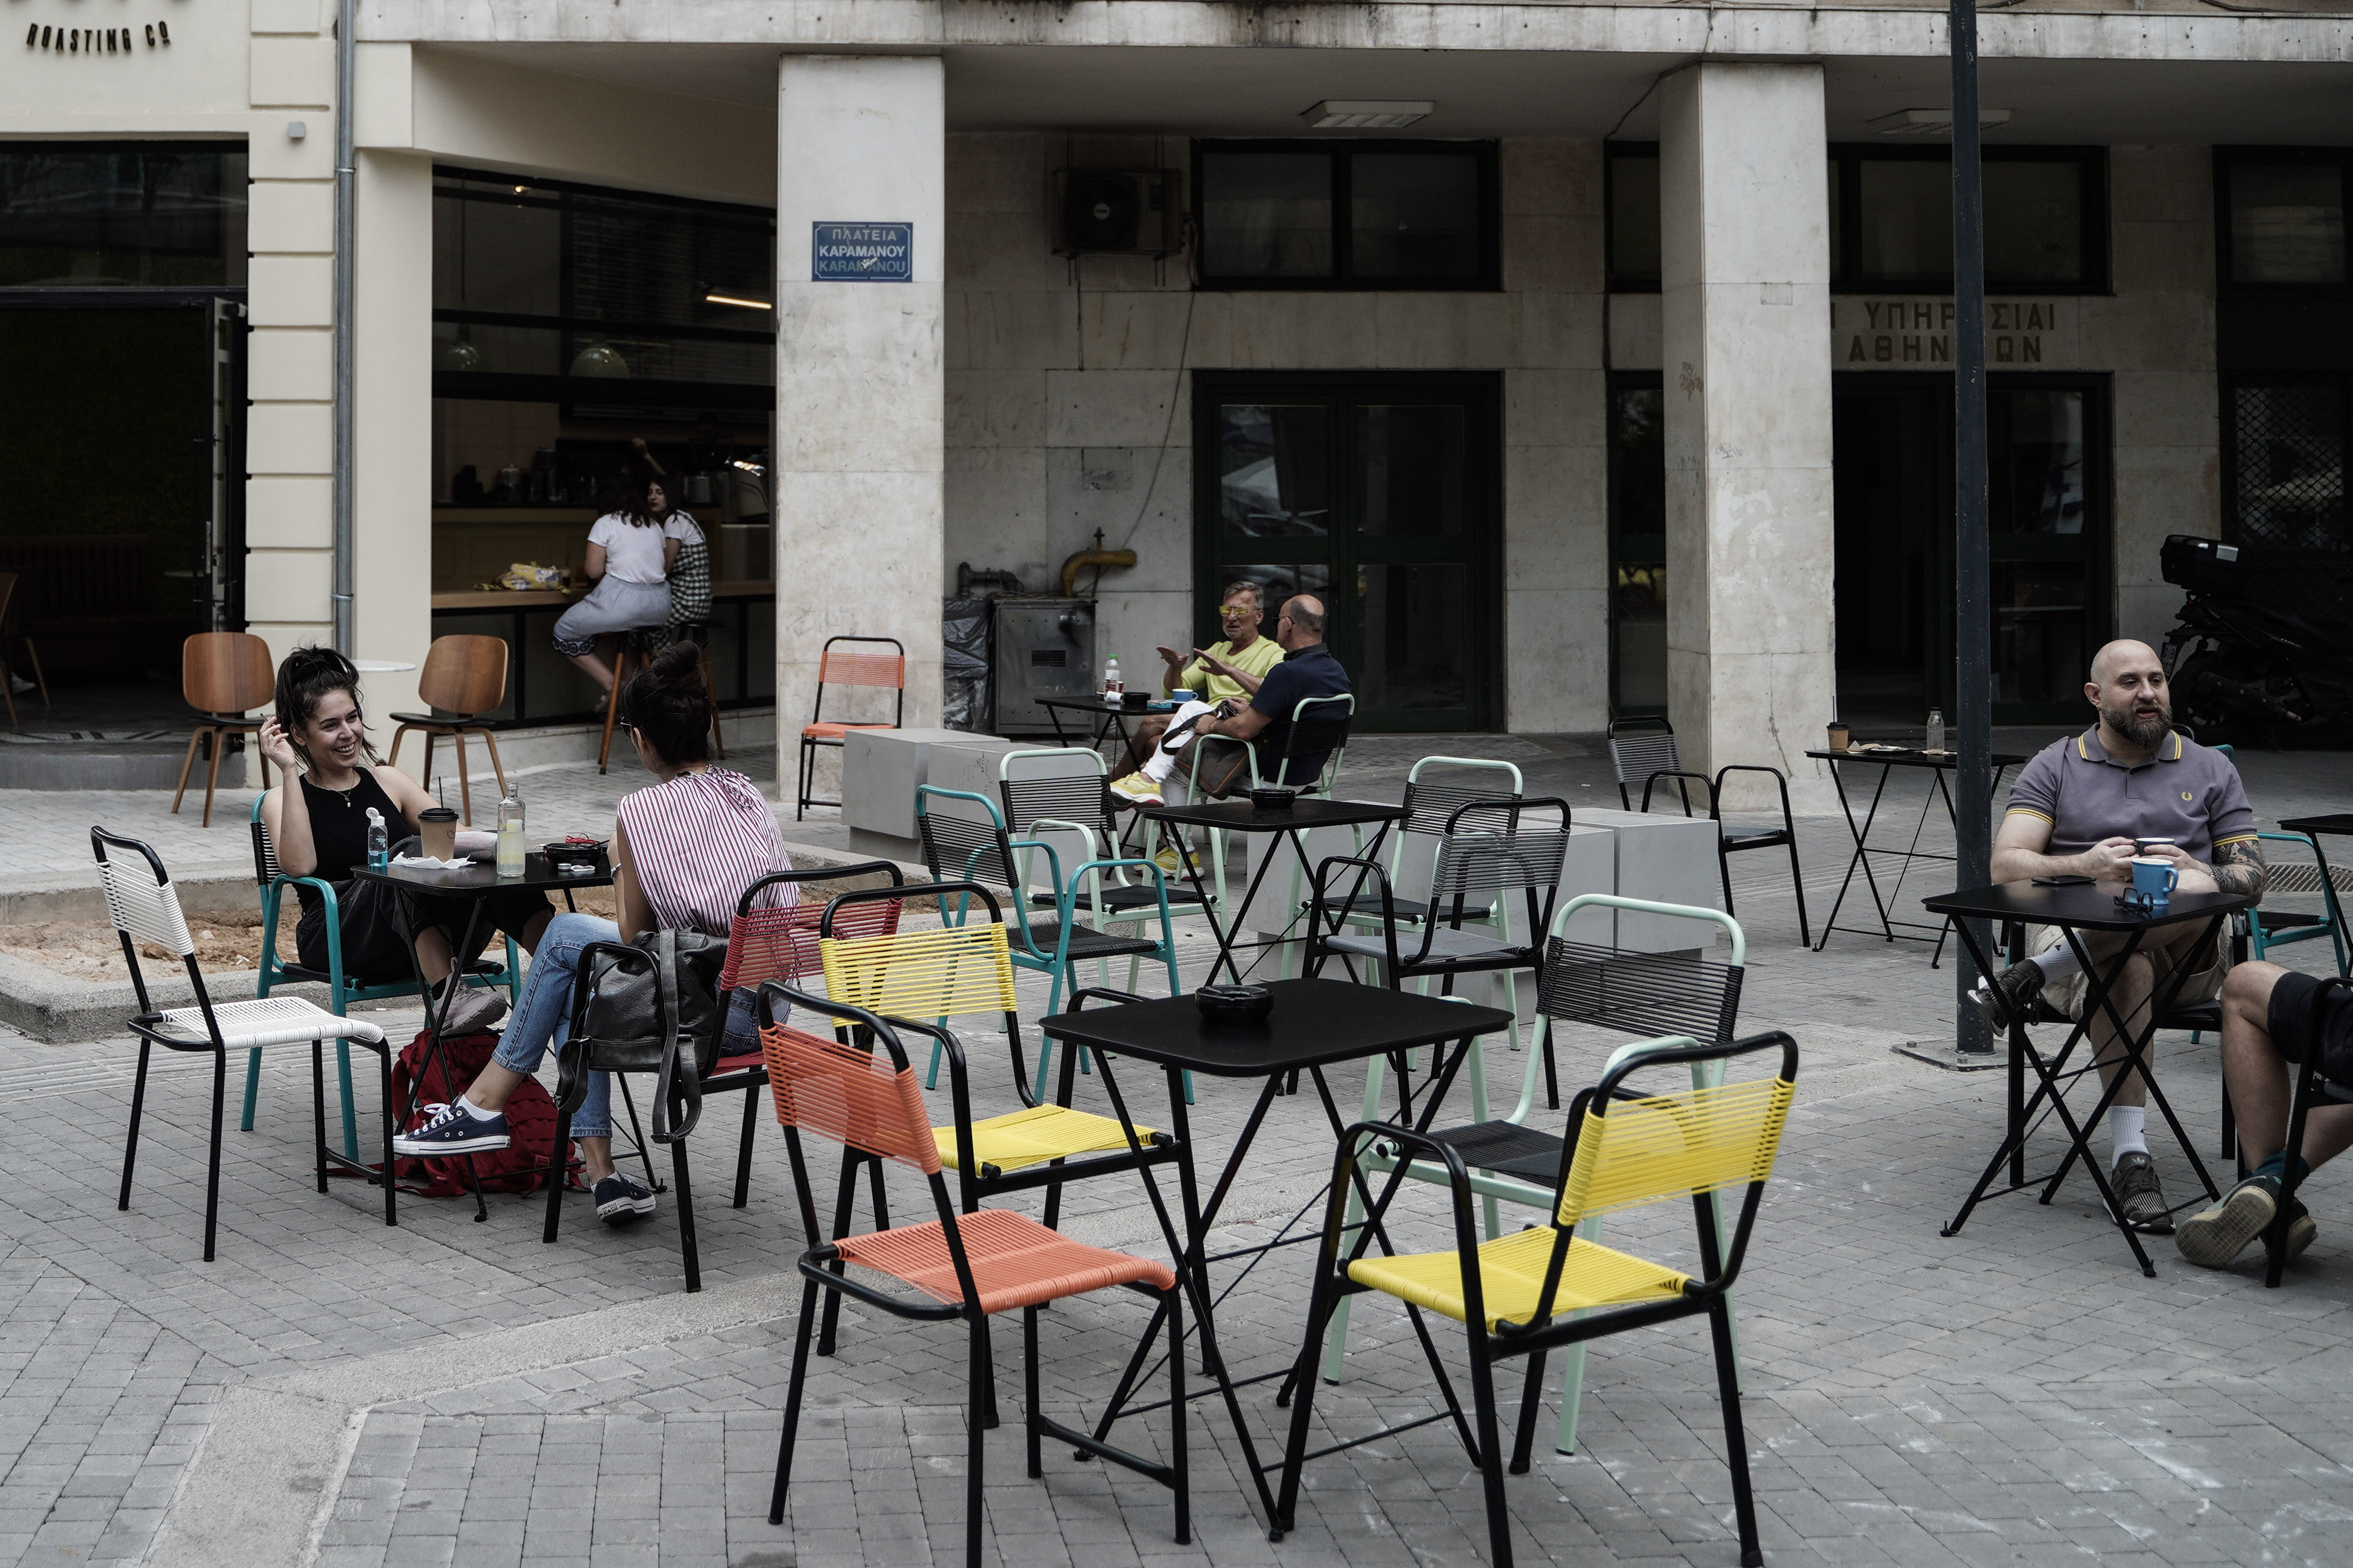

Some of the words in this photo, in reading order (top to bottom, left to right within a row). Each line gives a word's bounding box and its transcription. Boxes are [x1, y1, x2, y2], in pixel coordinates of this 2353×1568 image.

[27, 22, 132, 52] ROASTING
[832, 228, 897, 241] ΠΛΑΤΕΙΑ
[819, 245, 905, 257] ΚΑΡΑΜΑΝΟΥ
[1865, 302, 2055, 330] ΥΠΗΡΣΙΑΙ
